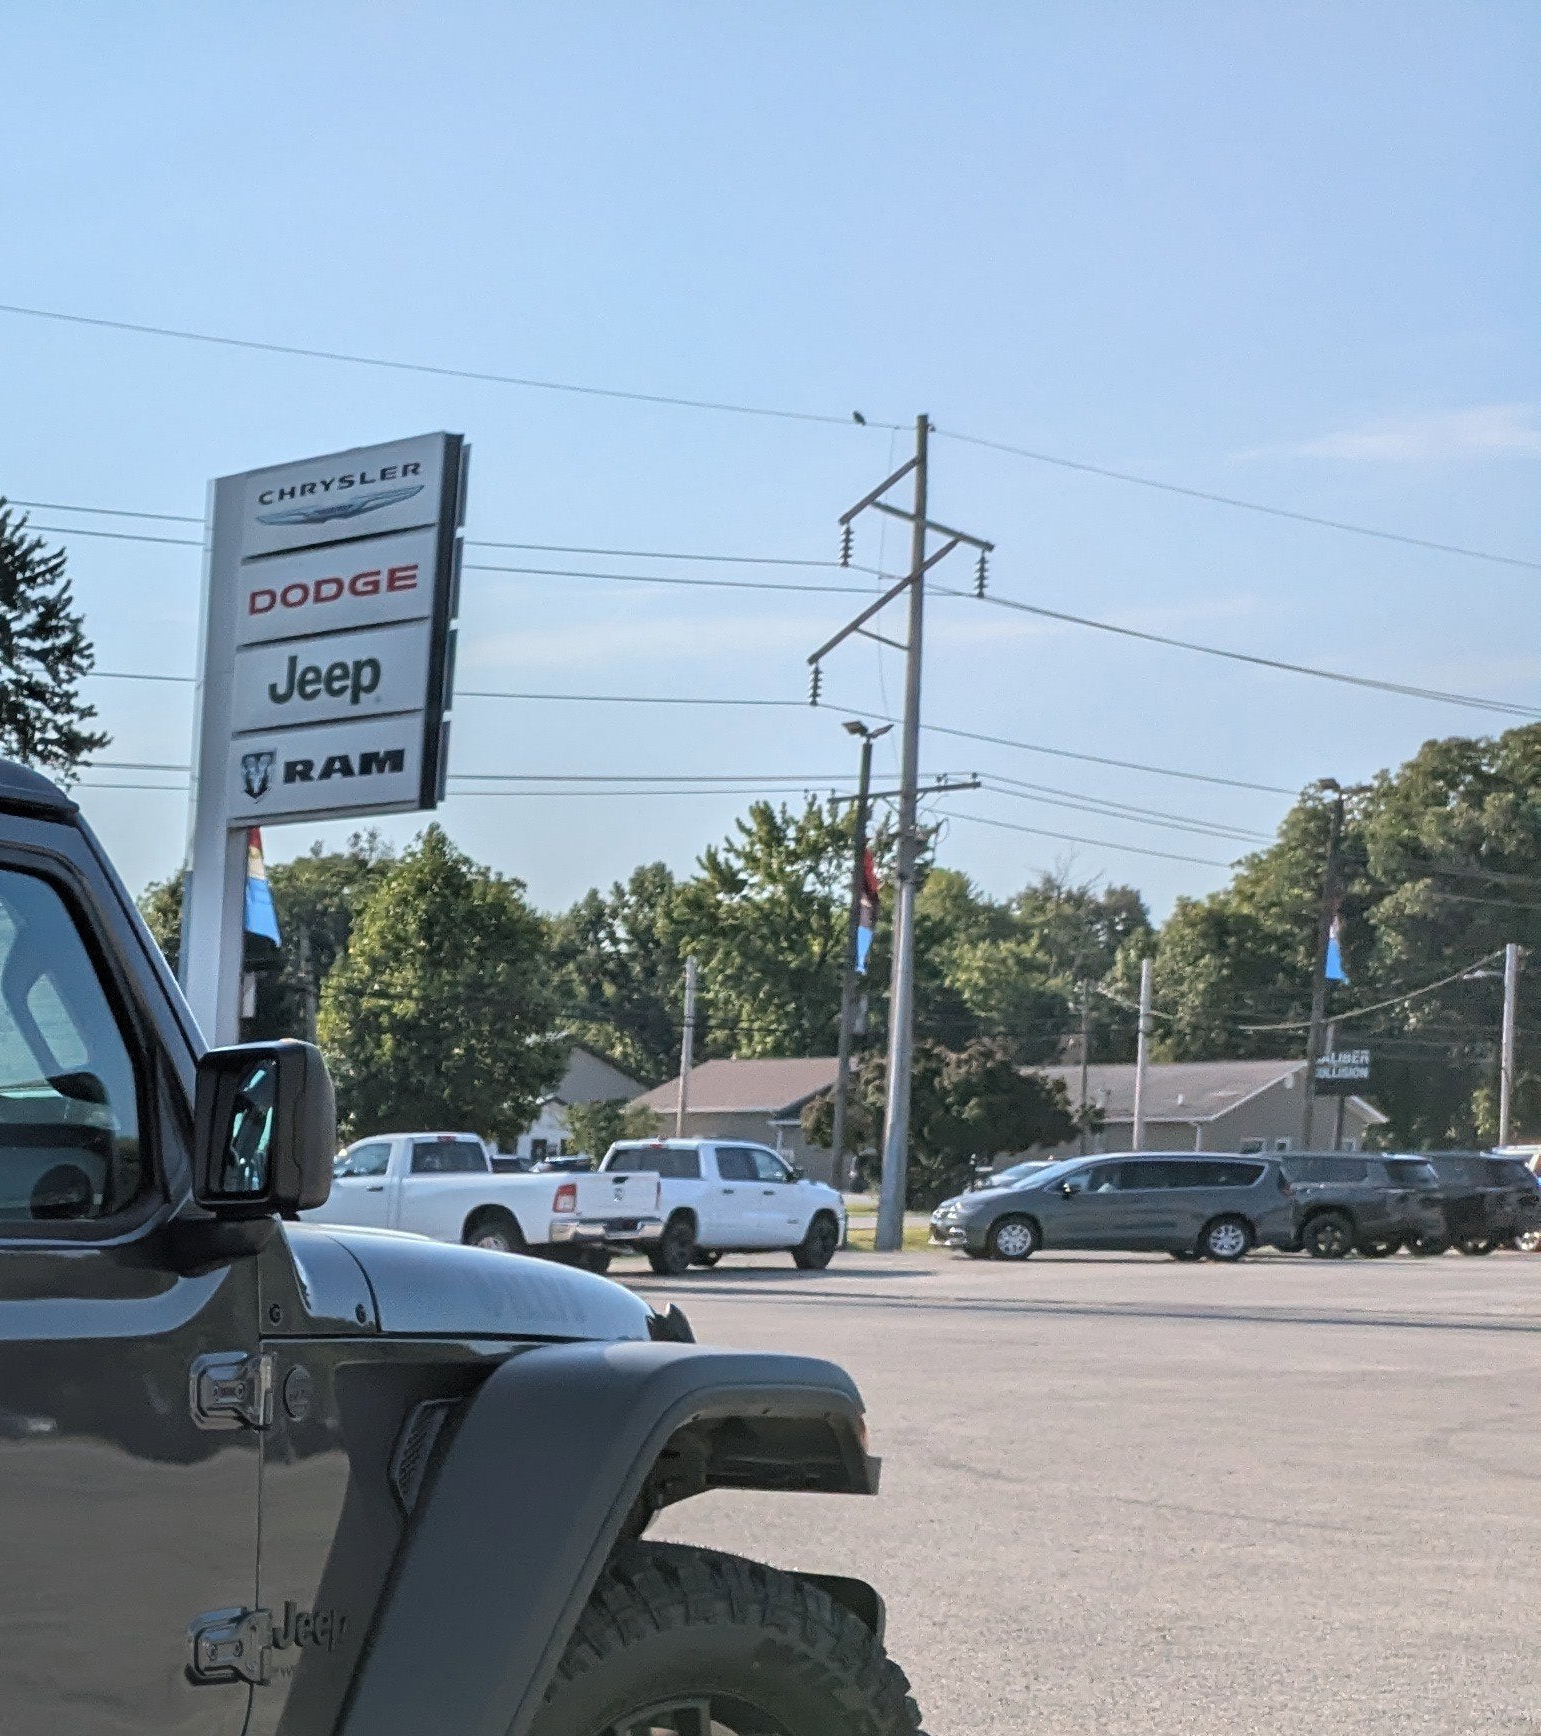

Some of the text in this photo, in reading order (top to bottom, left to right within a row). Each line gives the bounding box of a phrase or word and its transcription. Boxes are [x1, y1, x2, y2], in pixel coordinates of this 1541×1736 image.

[258, 461, 422, 506] CHRYSLER
[248, 564, 419, 616] DODGE
[267, 655, 381, 705] Jeep
[283, 748, 406, 784] RAM
[272, 1601, 347, 1652] Jeep
